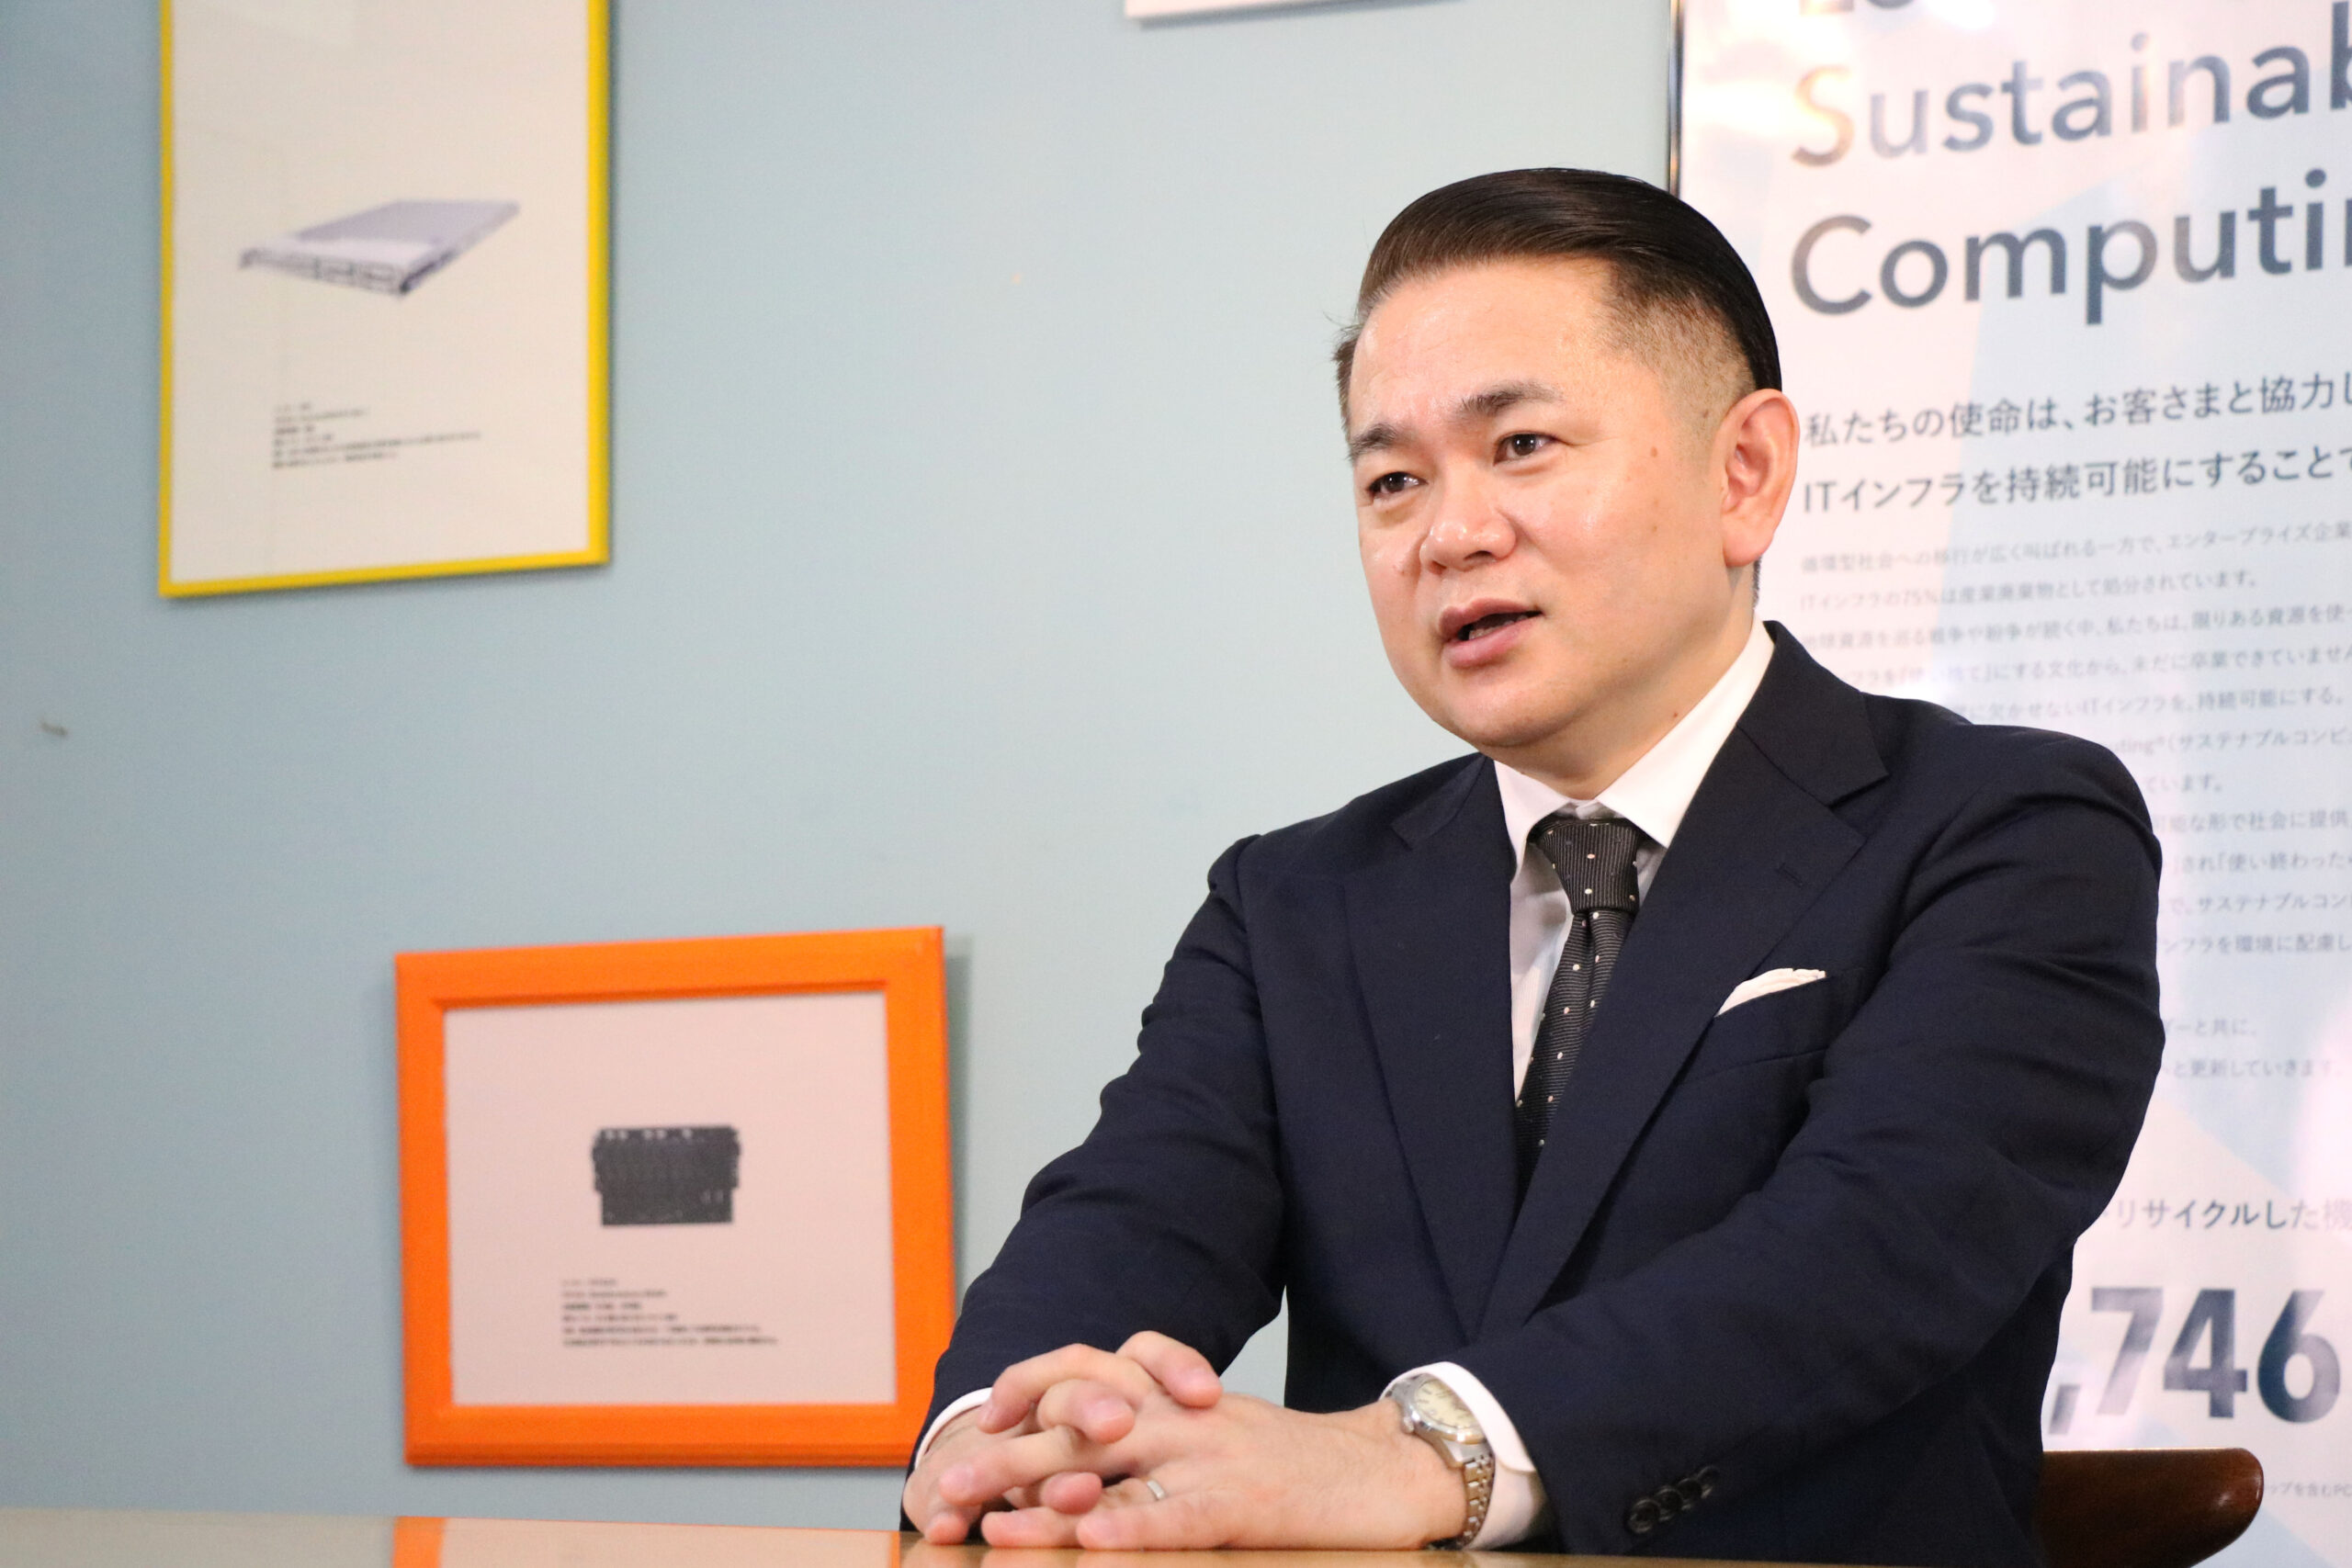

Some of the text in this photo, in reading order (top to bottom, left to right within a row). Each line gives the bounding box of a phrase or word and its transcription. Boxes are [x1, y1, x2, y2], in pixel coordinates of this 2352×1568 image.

[1792, 169, 2352, 326] Computi
[2169, 892, 2352, 915] で、サステナブルコン
[2162, 1058, 2345, 1079] と更新していきます。
